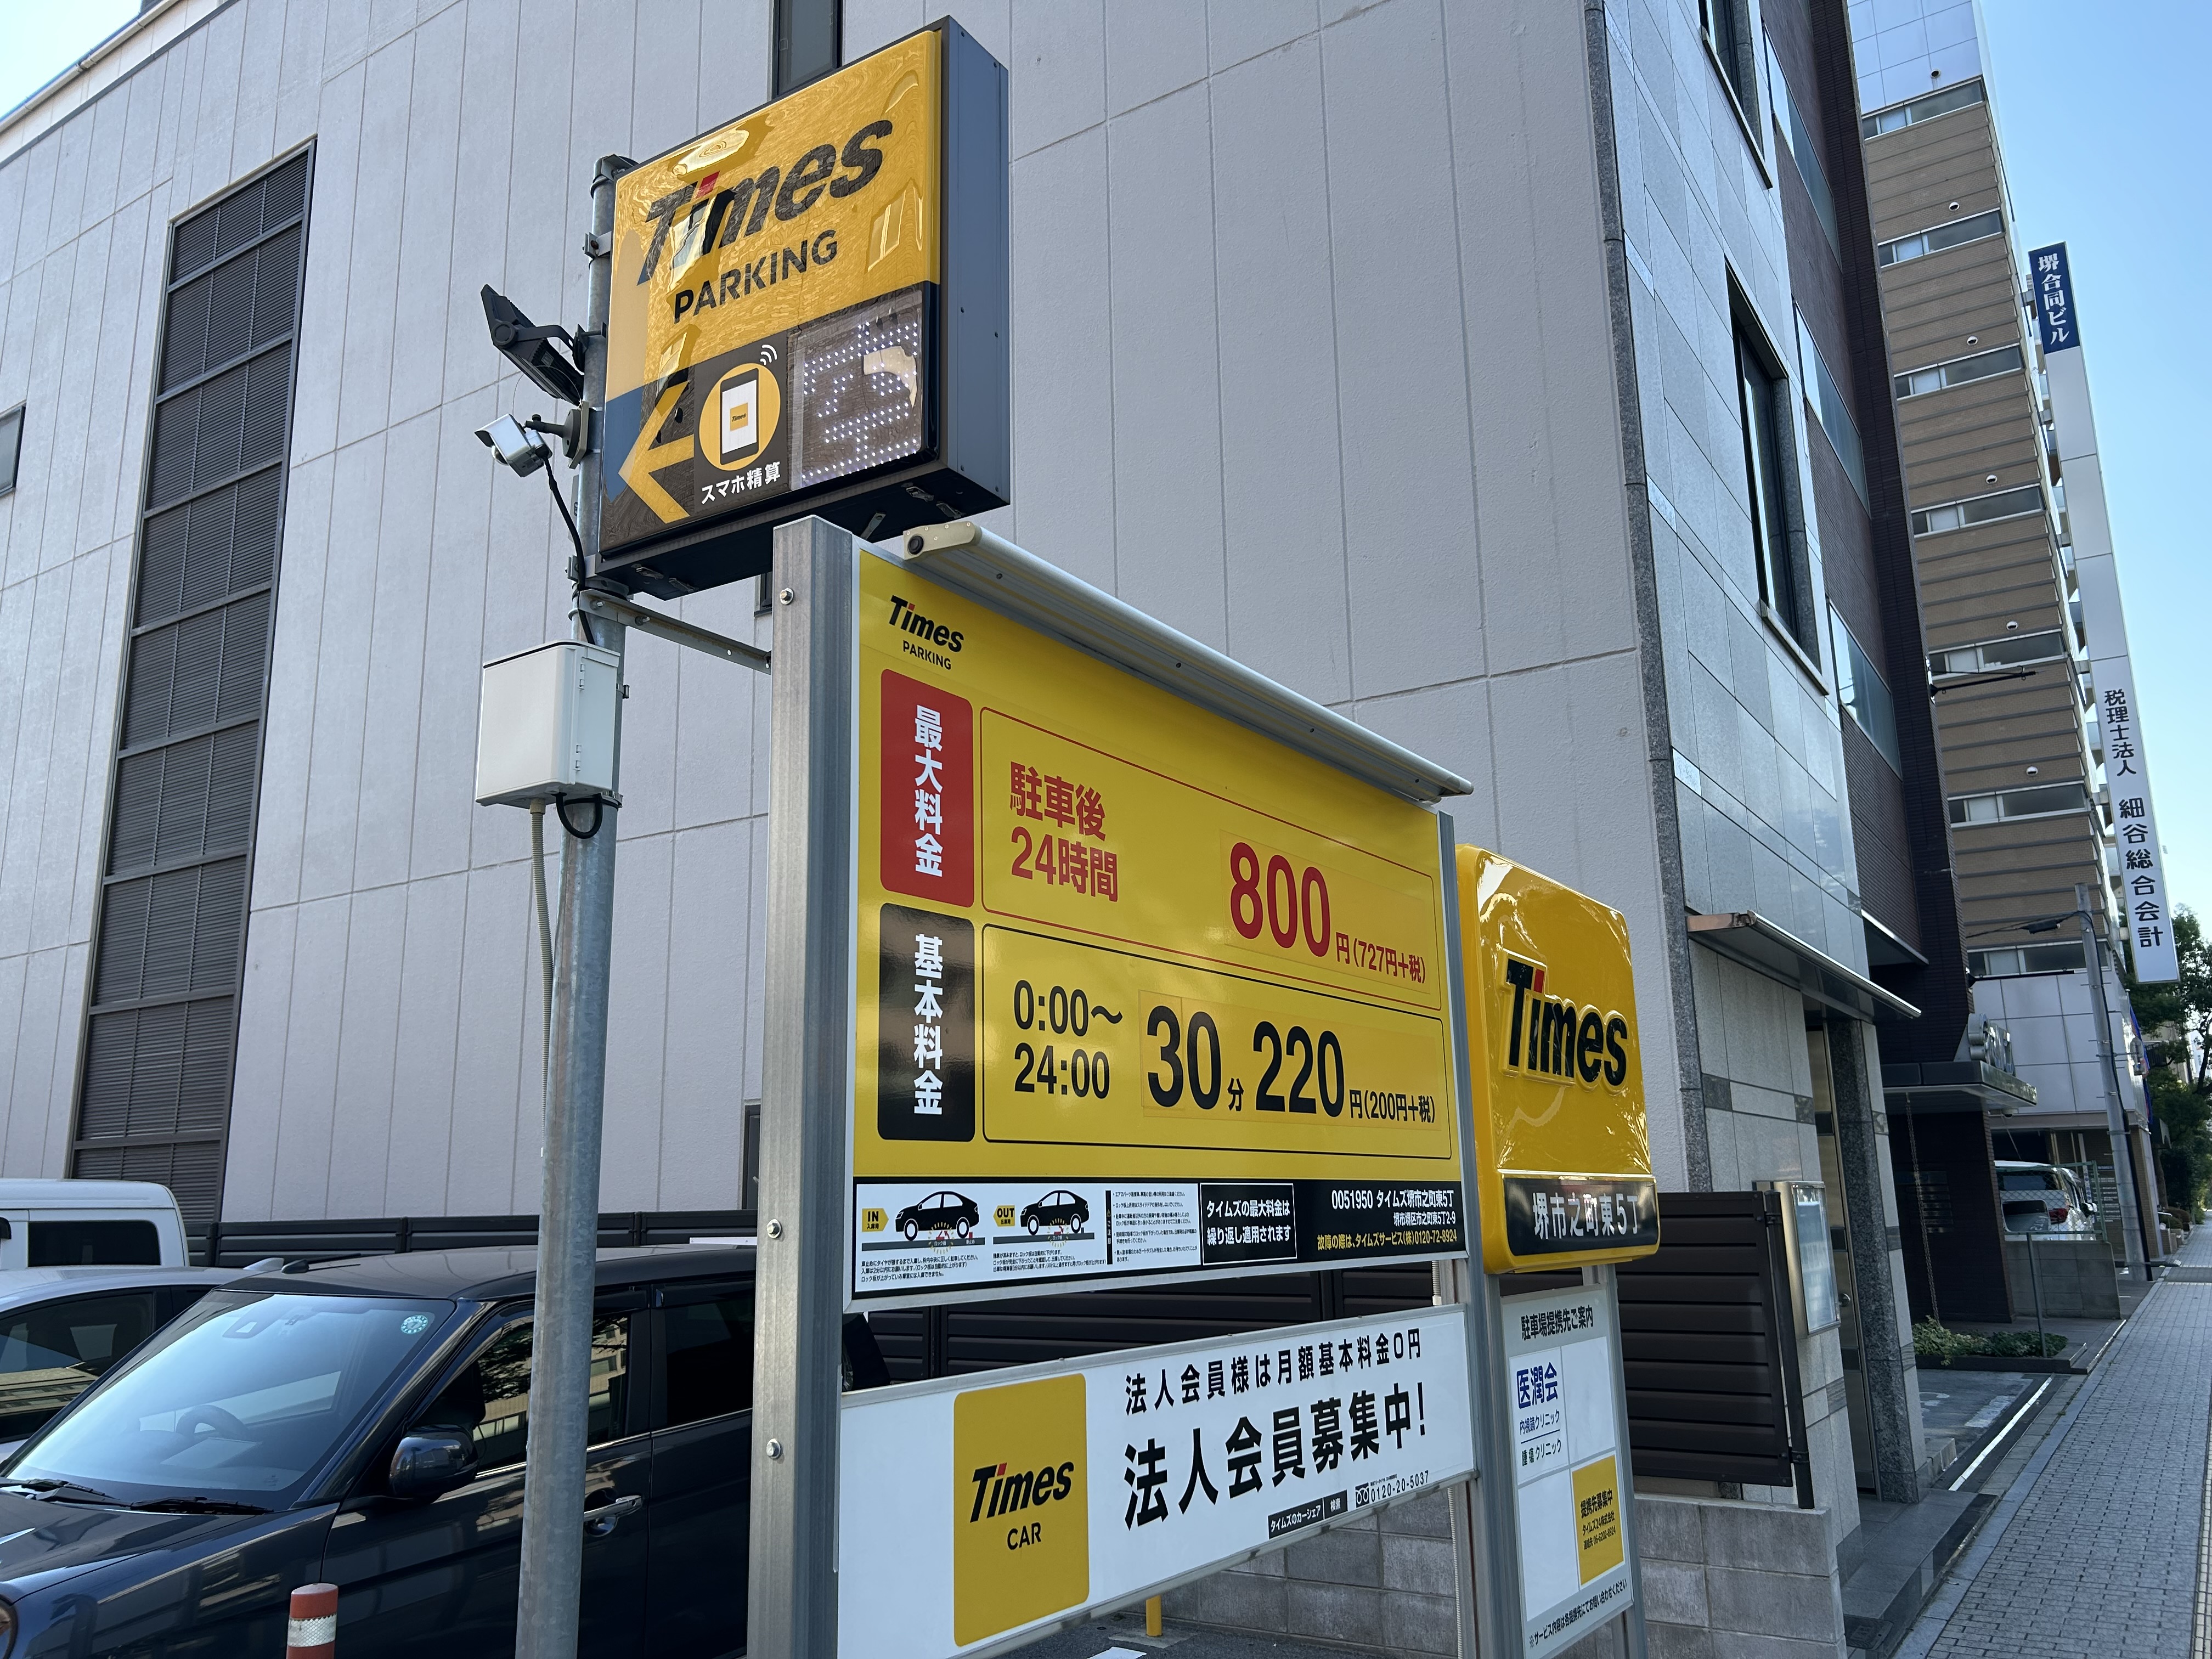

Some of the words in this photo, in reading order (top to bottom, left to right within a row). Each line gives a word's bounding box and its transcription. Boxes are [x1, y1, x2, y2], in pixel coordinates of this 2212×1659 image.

[637, 119, 893, 286] Times
[674, 229, 838, 323] PARKING
[2038, 253, 2069, 345] 堺合同ビル
[701, 462, 781, 504] スマホ精算
[888, 595, 964, 653] Times
[903, 641, 951, 670] PARKING
[2104, 688, 2137, 776] 税理士法人
[915, 705, 943, 878] 最大料金
[1010, 761, 1107, 842] 駐車後
[1011, 826, 1118, 902] 24時間
[2118, 797, 2164, 947] 細谷総合会計
[914, 934, 943, 1115] 基本料金
[1507, 958, 1627, 1087] Times
[1014, 1042, 1110, 1099] 24:00
[867, 1211, 879, 1222] IN
[997, 1207, 1014, 1218] OUT
[1206, 1199, 1290, 1217] タイムズの最大料金は
[1331, 1190, 1373, 1210] 0051950
[1376, 1189, 1454, 1209] タイムズ堺市之町東5丁
[1393, 1211, 1456, 1226] 堺市堺区市之町東5丁2-9
[1532, 1191, 1640, 1241] 堺市之町東5丁
[1207, 1224, 1291, 1246] 繰り返し適用されます
[1521, 1305, 1593, 1341] 駐車場提携先ご案内
[1125, 1328, 1421, 1416] 法人会員様は月額基本料金0円
[1516, 1362, 1558, 1409] 医潤会
[1520, 1409, 1560, 1435] 内視鏡クリニック
[1124, 1382, 1425, 1531] 法人会員募集中!
[969, 1461, 1074, 1523] Times
[1330, 1498, 1341, 1513] 検索
[1370, 1470, 1429, 1503] 0120-20-5037
[1580, 1487, 1613, 1519] 提携先募集中
[1007, 1522, 1042, 1550] CAR
[1270, 1505, 1321, 1533] タイムズのカーシェア
